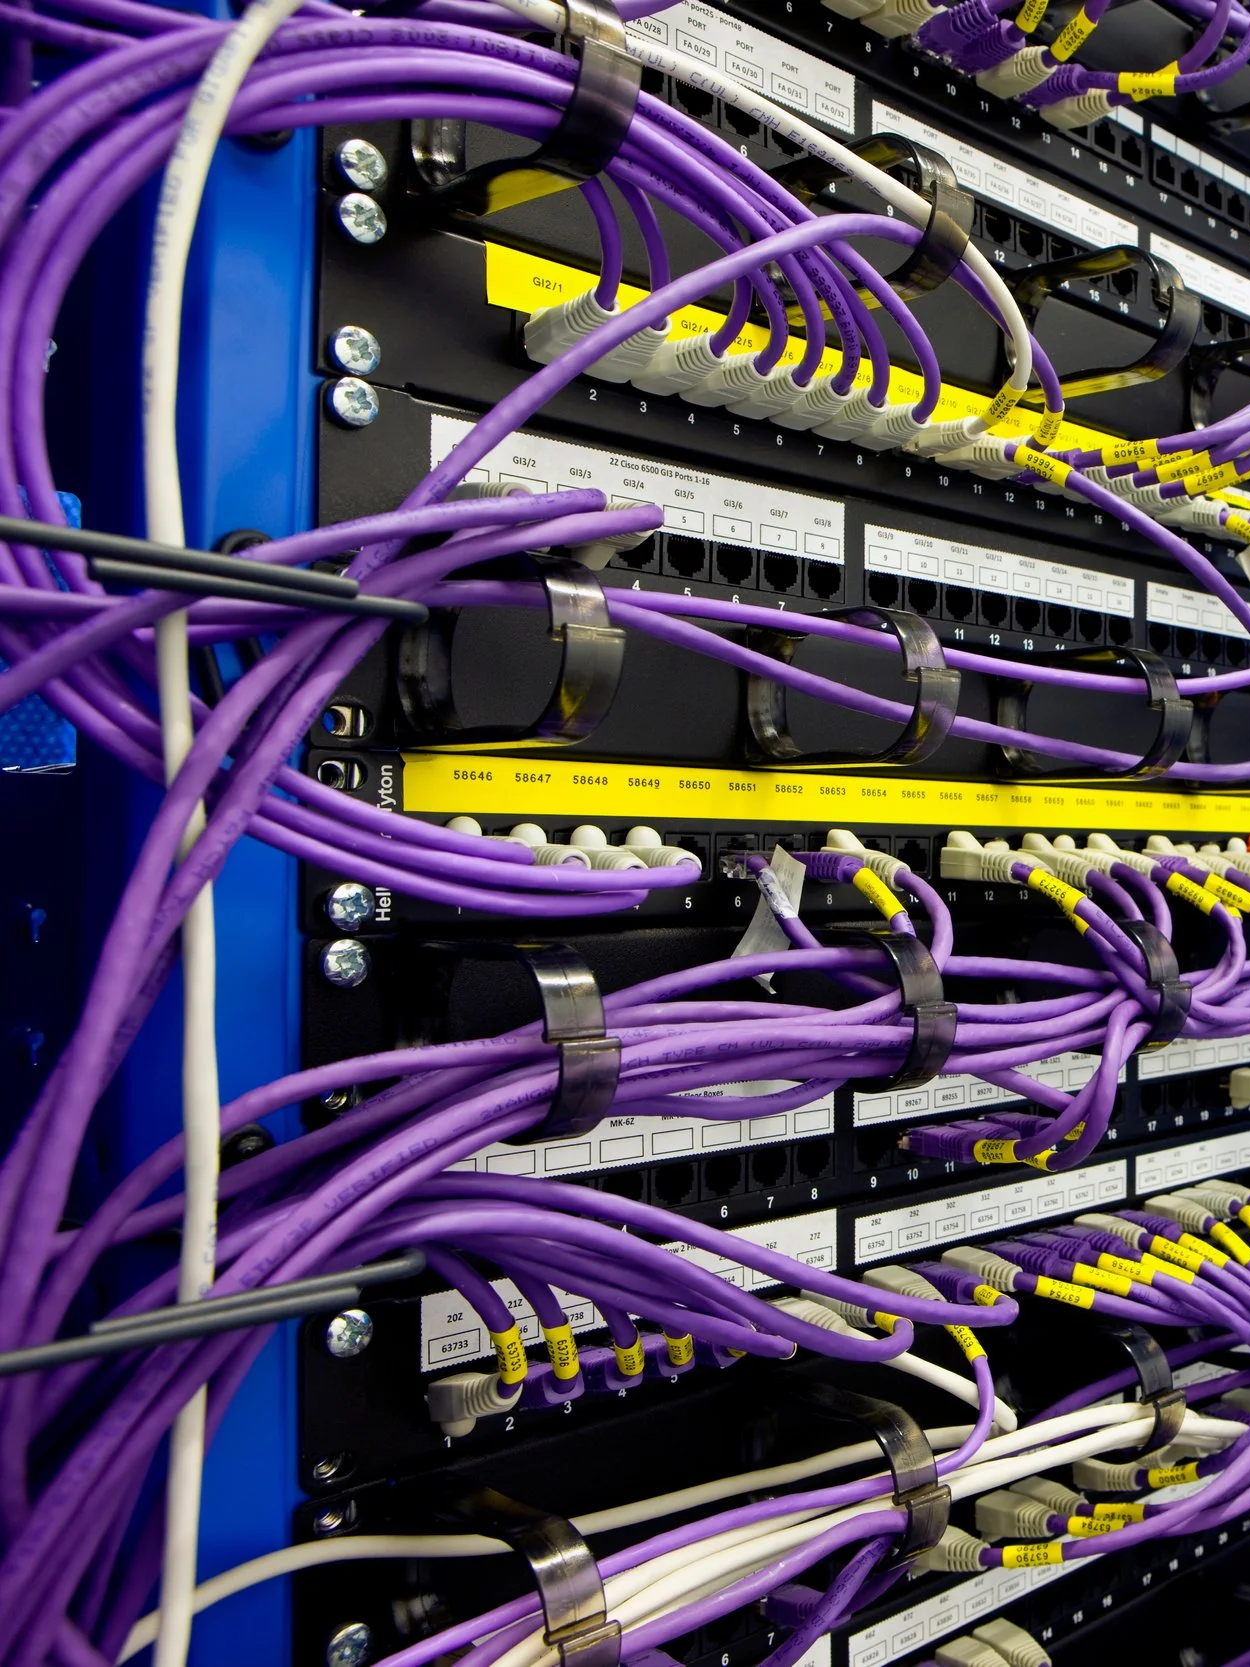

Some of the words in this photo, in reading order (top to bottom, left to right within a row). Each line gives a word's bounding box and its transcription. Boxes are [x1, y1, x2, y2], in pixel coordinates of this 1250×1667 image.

[786, 2, 793, 13] 6
[690, 2, 714, 18] port25
[719, 16, 742, 32] port48
[644, 21, 662, 35] 0/28
[687, 17, 707, 31] PORT
[826, 22, 833, 33] 7
[1063, 28, 1084, 50] 89267
[683, 39, 692, 50] FA
[693, 43, 711, 58] 0/29
[735, 39, 754, 53] PORT
[865, 42, 872, 53] 8
[731, 61, 741, 72] FA
[741, 66, 758, 80] 0/30
[781, 61, 799, 74] PORT
[913, 66, 920, 77] 9
[777, 82, 786, 92] FA
[787, 85, 802, 99] 0/31
[824, 81, 841, 93] PORT
[946, 84, 956, 96] 10
[821, 102, 829, 112] FA
[830, 106, 845, 119] 0/32
[980, 101, 989, 112] 11
[885, 110, 901, 123] PORT
[1012, 116, 1021, 128] 12
[1042, 132, 1051, 144] 13
[740, 145, 748, 157] 6
[1071, 148, 1080, 159] 14
[829, 182, 836, 194] 8
[887, 205, 894, 216] 9
[994, 250, 1005, 262] 12
[532, 276, 563, 293] GI2/1
[1089, 289, 1100, 301] 15
[1118, 302, 1129, 314] 16
[589, 389, 597, 400] 2
[898, 384, 920, 399] GI2/9
[640, 402, 647, 413] 3
[989, 392, 1006, 415] 63822
[688, 413, 695, 424] 4
[733, 424, 740, 436] 5
[776, 434, 783, 446] 6
[818, 446, 824, 456] 7
[1114, 446, 1146, 458] 59408
[512, 456, 536, 468] GI3/2
[857, 456, 863, 466] 8
[1027, 454, 1056, 472] 76668
[569, 468, 592, 479] GI3/3
[609, 457, 618, 466] 2Z
[620, 460, 640, 471] Cisco
[641, 464, 659, 476] 6500
[660, 468, 673, 478] GI3
[674, 471, 693, 483] Ports
[694, 474, 710, 486] 1-16
[906, 468, 912, 478] 9
[623, 478, 644, 490] GI3/4
[938, 476, 949, 487] 10
[674, 488, 694, 500] GI3/5
[973, 484, 982, 495] 11
[1004, 492, 1014, 502] 12
[724, 499, 742, 510] GI3/6
[1036, 500, 1045, 510] 13
[770, 508, 788, 519] GI3/7
[1066, 507, 1074, 518] 14
[682, 515, 686, 524] 5
[814, 518, 832, 528] GI3/8
[1094, 515, 1102, 525] 15
[730, 524, 736, 534] 6
[878, 530, 894, 540] GI3/9
[777, 534, 782, 542] 7
[914, 538, 933, 548] GI3/10
[632, 580, 640, 592] 4
[684, 587, 692, 597] 5
[732, 594, 740, 604] 6
[778, 601, 785, 612] 7
[954, 628, 964, 640] 11
[990, 633, 1000, 646] 12
[1023, 638, 1034, 650] 13
[453, 770, 492, 782] 58646
[515, 772, 551, 784] 58647
[572, 774, 608, 786] 58648
[628, 777, 660, 788] 58649
[679, 780, 710, 790] 58650
[729, 782, 756, 792] 58651
[775, 784, 803, 794] 58652
[820, 786, 846, 796] 58653
[862, 788, 887, 798] 58654
[902, 790, 926, 799] 58655
[940, 792, 962, 800] 58656
[976, 794, 998, 802] 58657
[1019, 890, 1028, 900] 13
[1039, 879, 1066, 899] 93273
[734, 896, 741, 907] 6
[826, 894, 833, 904] 8
[948, 892, 956, 902] 11
[984, 891, 993, 900] 12
[685, 897, 692, 909] 5
[704, 1089, 724, 1098] Boxes
[942, 1092, 958, 1101] 89255
[905, 1098, 922, 1108] 89267
[610, 1117, 634, 1128] MK-6Z
[1148, 1120, 1156, 1132] 17
[1108, 1128, 1117, 1140] 16
[982, 1151, 1004, 1162] 89267
[945, 1161, 954, 1172] 11
[908, 1168, 918, 1180] 10
[870, 1176, 877, 1188] 9
[811, 1188, 818, 1200] 8
[768, 1196, 774, 1208] 7
[720, 1204, 728, 1218] 6
[942, 1222, 959, 1232] 63754
[906, 1230, 923, 1240] 63752
[867, 1239, 885, 1250] 63750
[805, 1254, 825, 1265] 63748
[1050, 1288, 1080, 1304] 63754
[442, 1340, 468, 1353] 63733
[506, 1342, 518, 1372] 63733
[558, 1339, 570, 1368] 63736
[564, 1400, 572, 1414] 3
[506, 1416, 514, 1431] 2
[444, 1436, 451, 1448] 1
[1082, 1521, 1110, 1532] 63794
[1016, 1552, 1048, 1562] 63790
[1142, 1573, 1152, 1586] 17
[1102, 1595, 1112, 1607] 16
[1073, 1610, 1084, 1624] 15
[768, 1632, 774, 1646] 7
[1042, 1628, 1052, 1640] 14
[722, 1654, 729, 1667] 6
